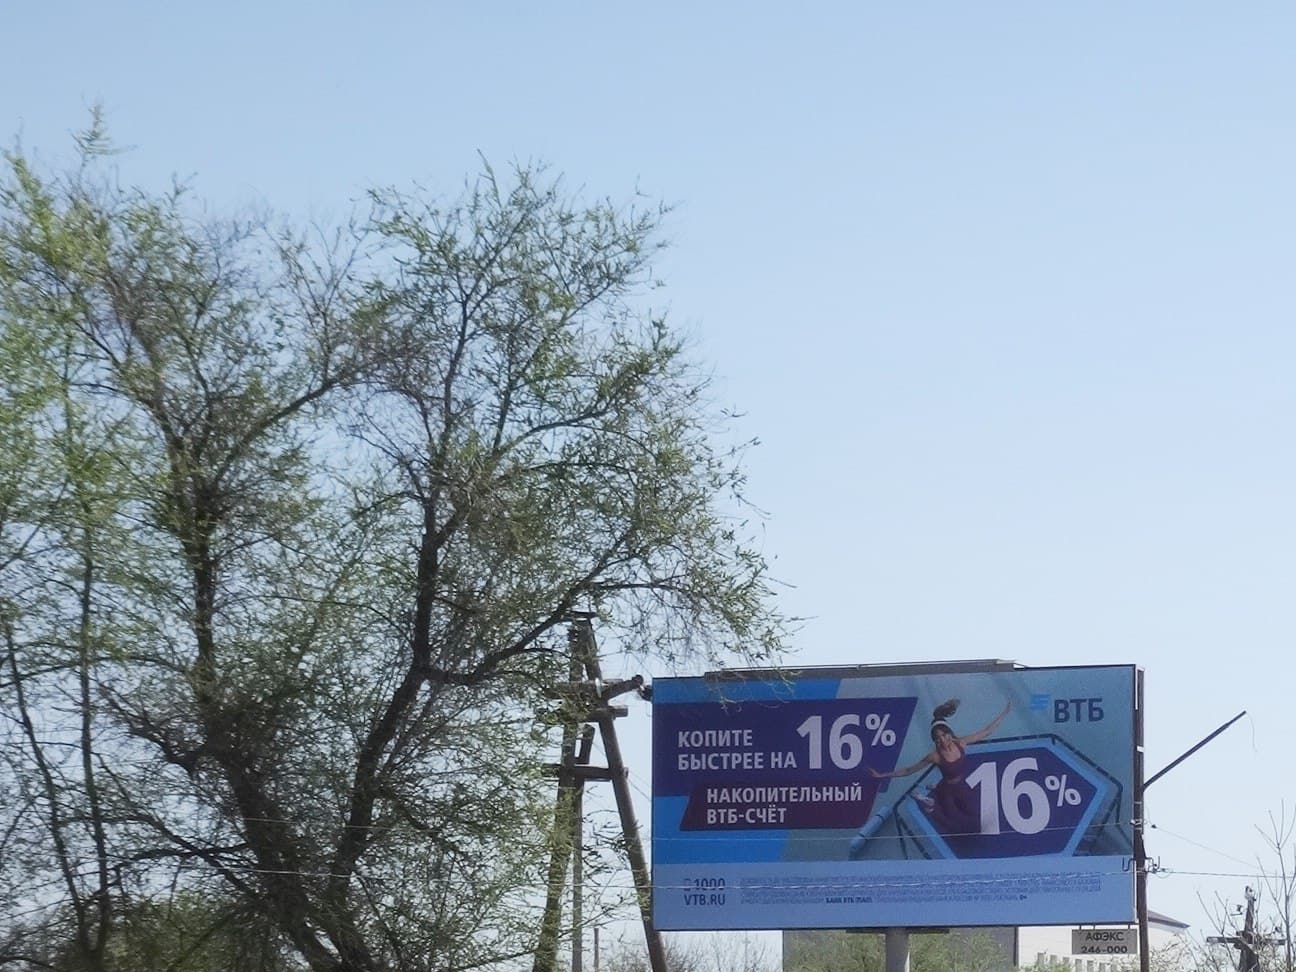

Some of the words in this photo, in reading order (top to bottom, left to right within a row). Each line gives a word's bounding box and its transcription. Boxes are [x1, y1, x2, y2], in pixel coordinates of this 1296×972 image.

[1054, 698, 1104, 723] ВТБ
[678, 729, 753, 747] КОПИТЕ
[678, 752, 764, 771] БЫСТРЕЕ
[771, 752, 797, 769] НА
[796, 713, 896, 770] 16%
[707, 782, 862, 803] НАКОПИТЕЛЬНЫЙ
[965, 757, 1082, 835] 16%
[707, 804, 787, 825] ВТБ-СЧЁТ
[693, 878, 726, 891] 1000
[684, 894, 726, 906] VTB.RU
[1085, 931, 1125, 941] АФЭКС
[1081, 945, 1128, 954] 246-000
